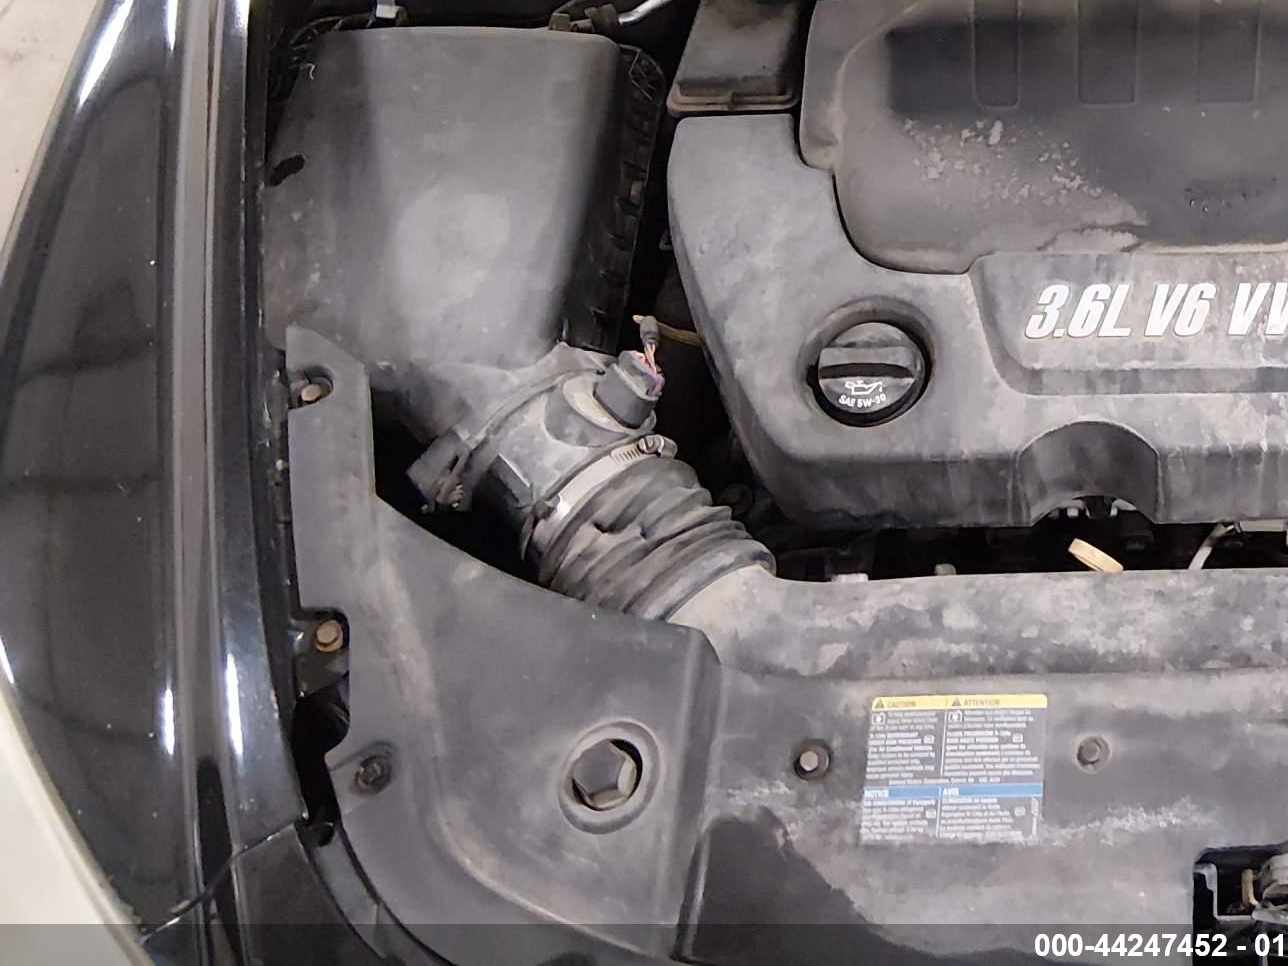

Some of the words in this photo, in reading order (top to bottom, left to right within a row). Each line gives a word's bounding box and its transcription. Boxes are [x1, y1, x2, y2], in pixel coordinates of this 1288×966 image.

[1024, 283, 1132, 338] 3.6L
[1144, 283, 1217, 337] V6
[839, 395, 855, 407] SAE
[857, 394, 887, 408] 5W-30
[864, 790, 889, 798] NOTICE
